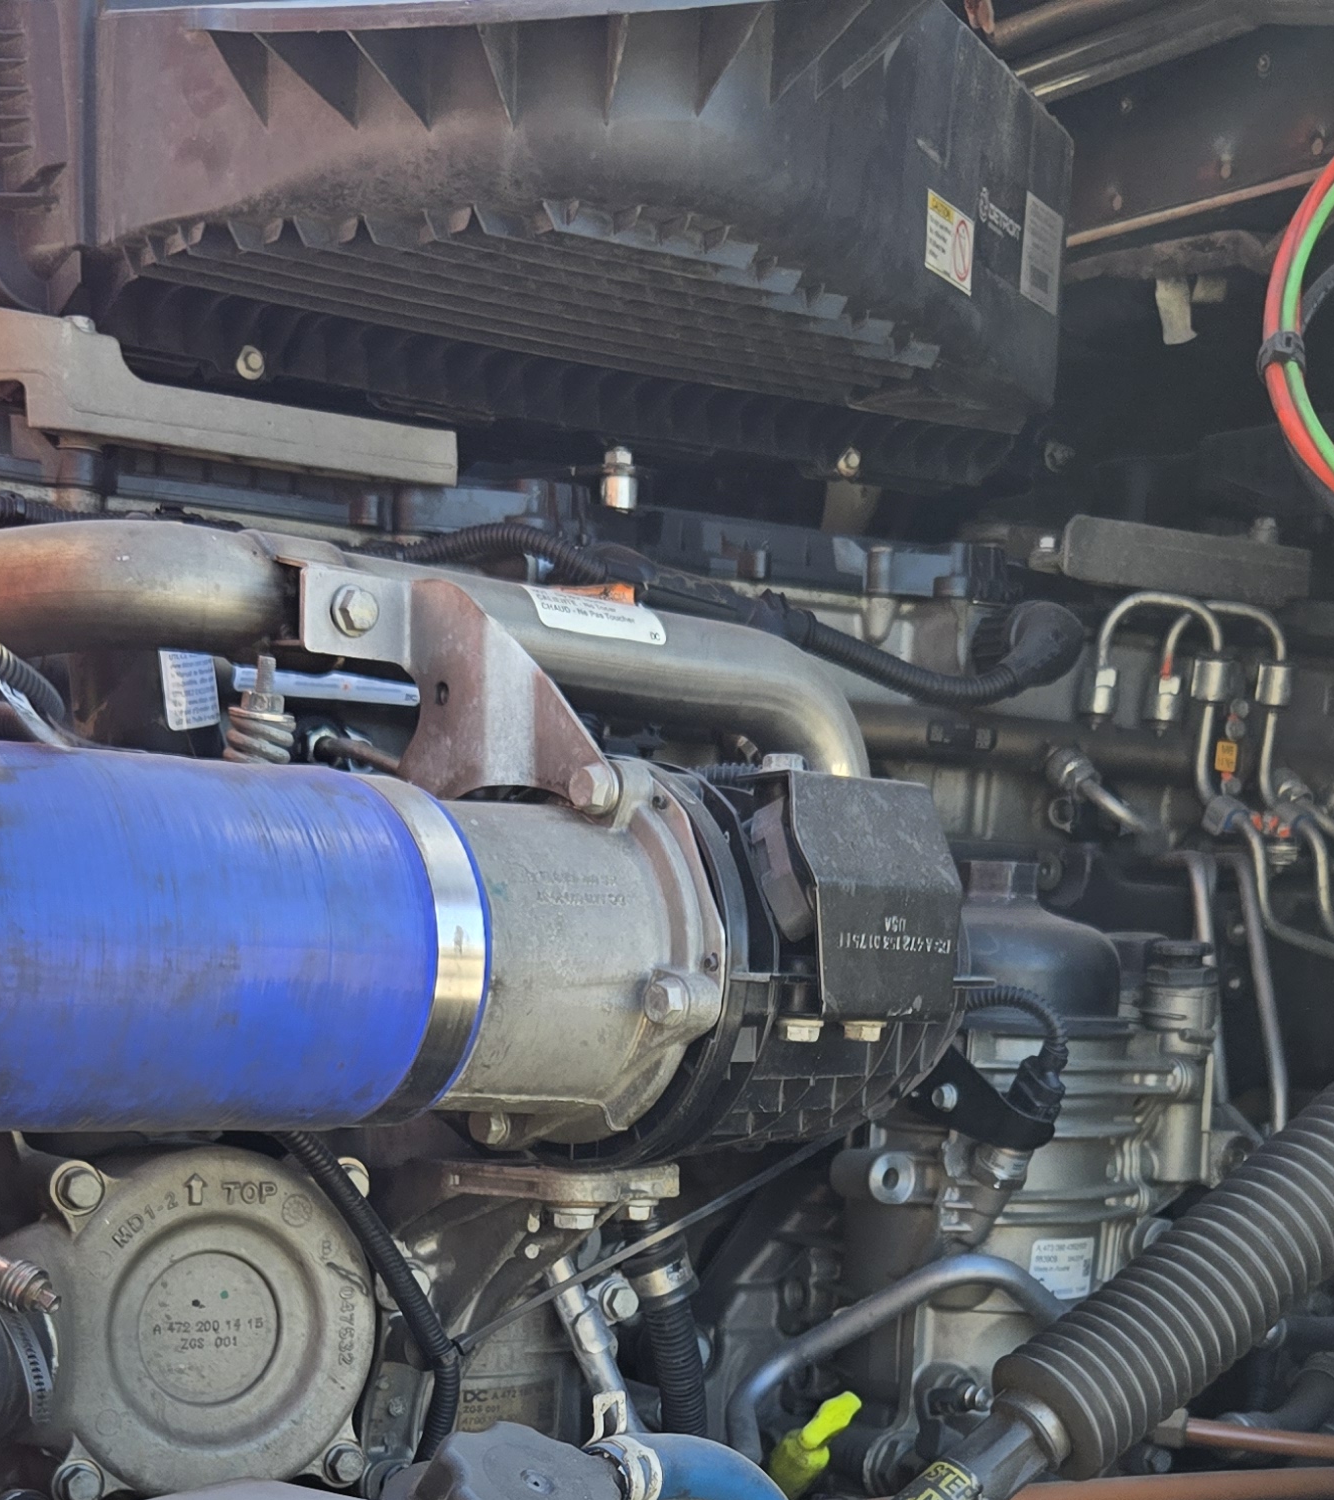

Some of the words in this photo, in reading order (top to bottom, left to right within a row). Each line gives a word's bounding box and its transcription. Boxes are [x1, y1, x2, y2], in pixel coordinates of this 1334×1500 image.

[988, 202, 1022, 240] DETROIT
[541, 602, 571, 614] CHAUD
[578, 607, 588, 616] Ne
[590, 610, 605, 619] Pas
[606, 613, 635, 623] Toucher
[583, 601, 594, 610] No
[885, 915, 907, 933] USA
[222, 1181, 278, 1205] TOP
[153, 1323, 162, 1336] A
[167, 1321, 191, 1335] 472
[196, 1320, 219, 1333] 200
[180, 1337, 205, 1350] ZGS
[214, 1336, 238, 1348] 001
[463, 1389, 488, 1403] DC
[491, 1390, 499, 1399] A
[463, 1405, 483, 1414] ZGS
